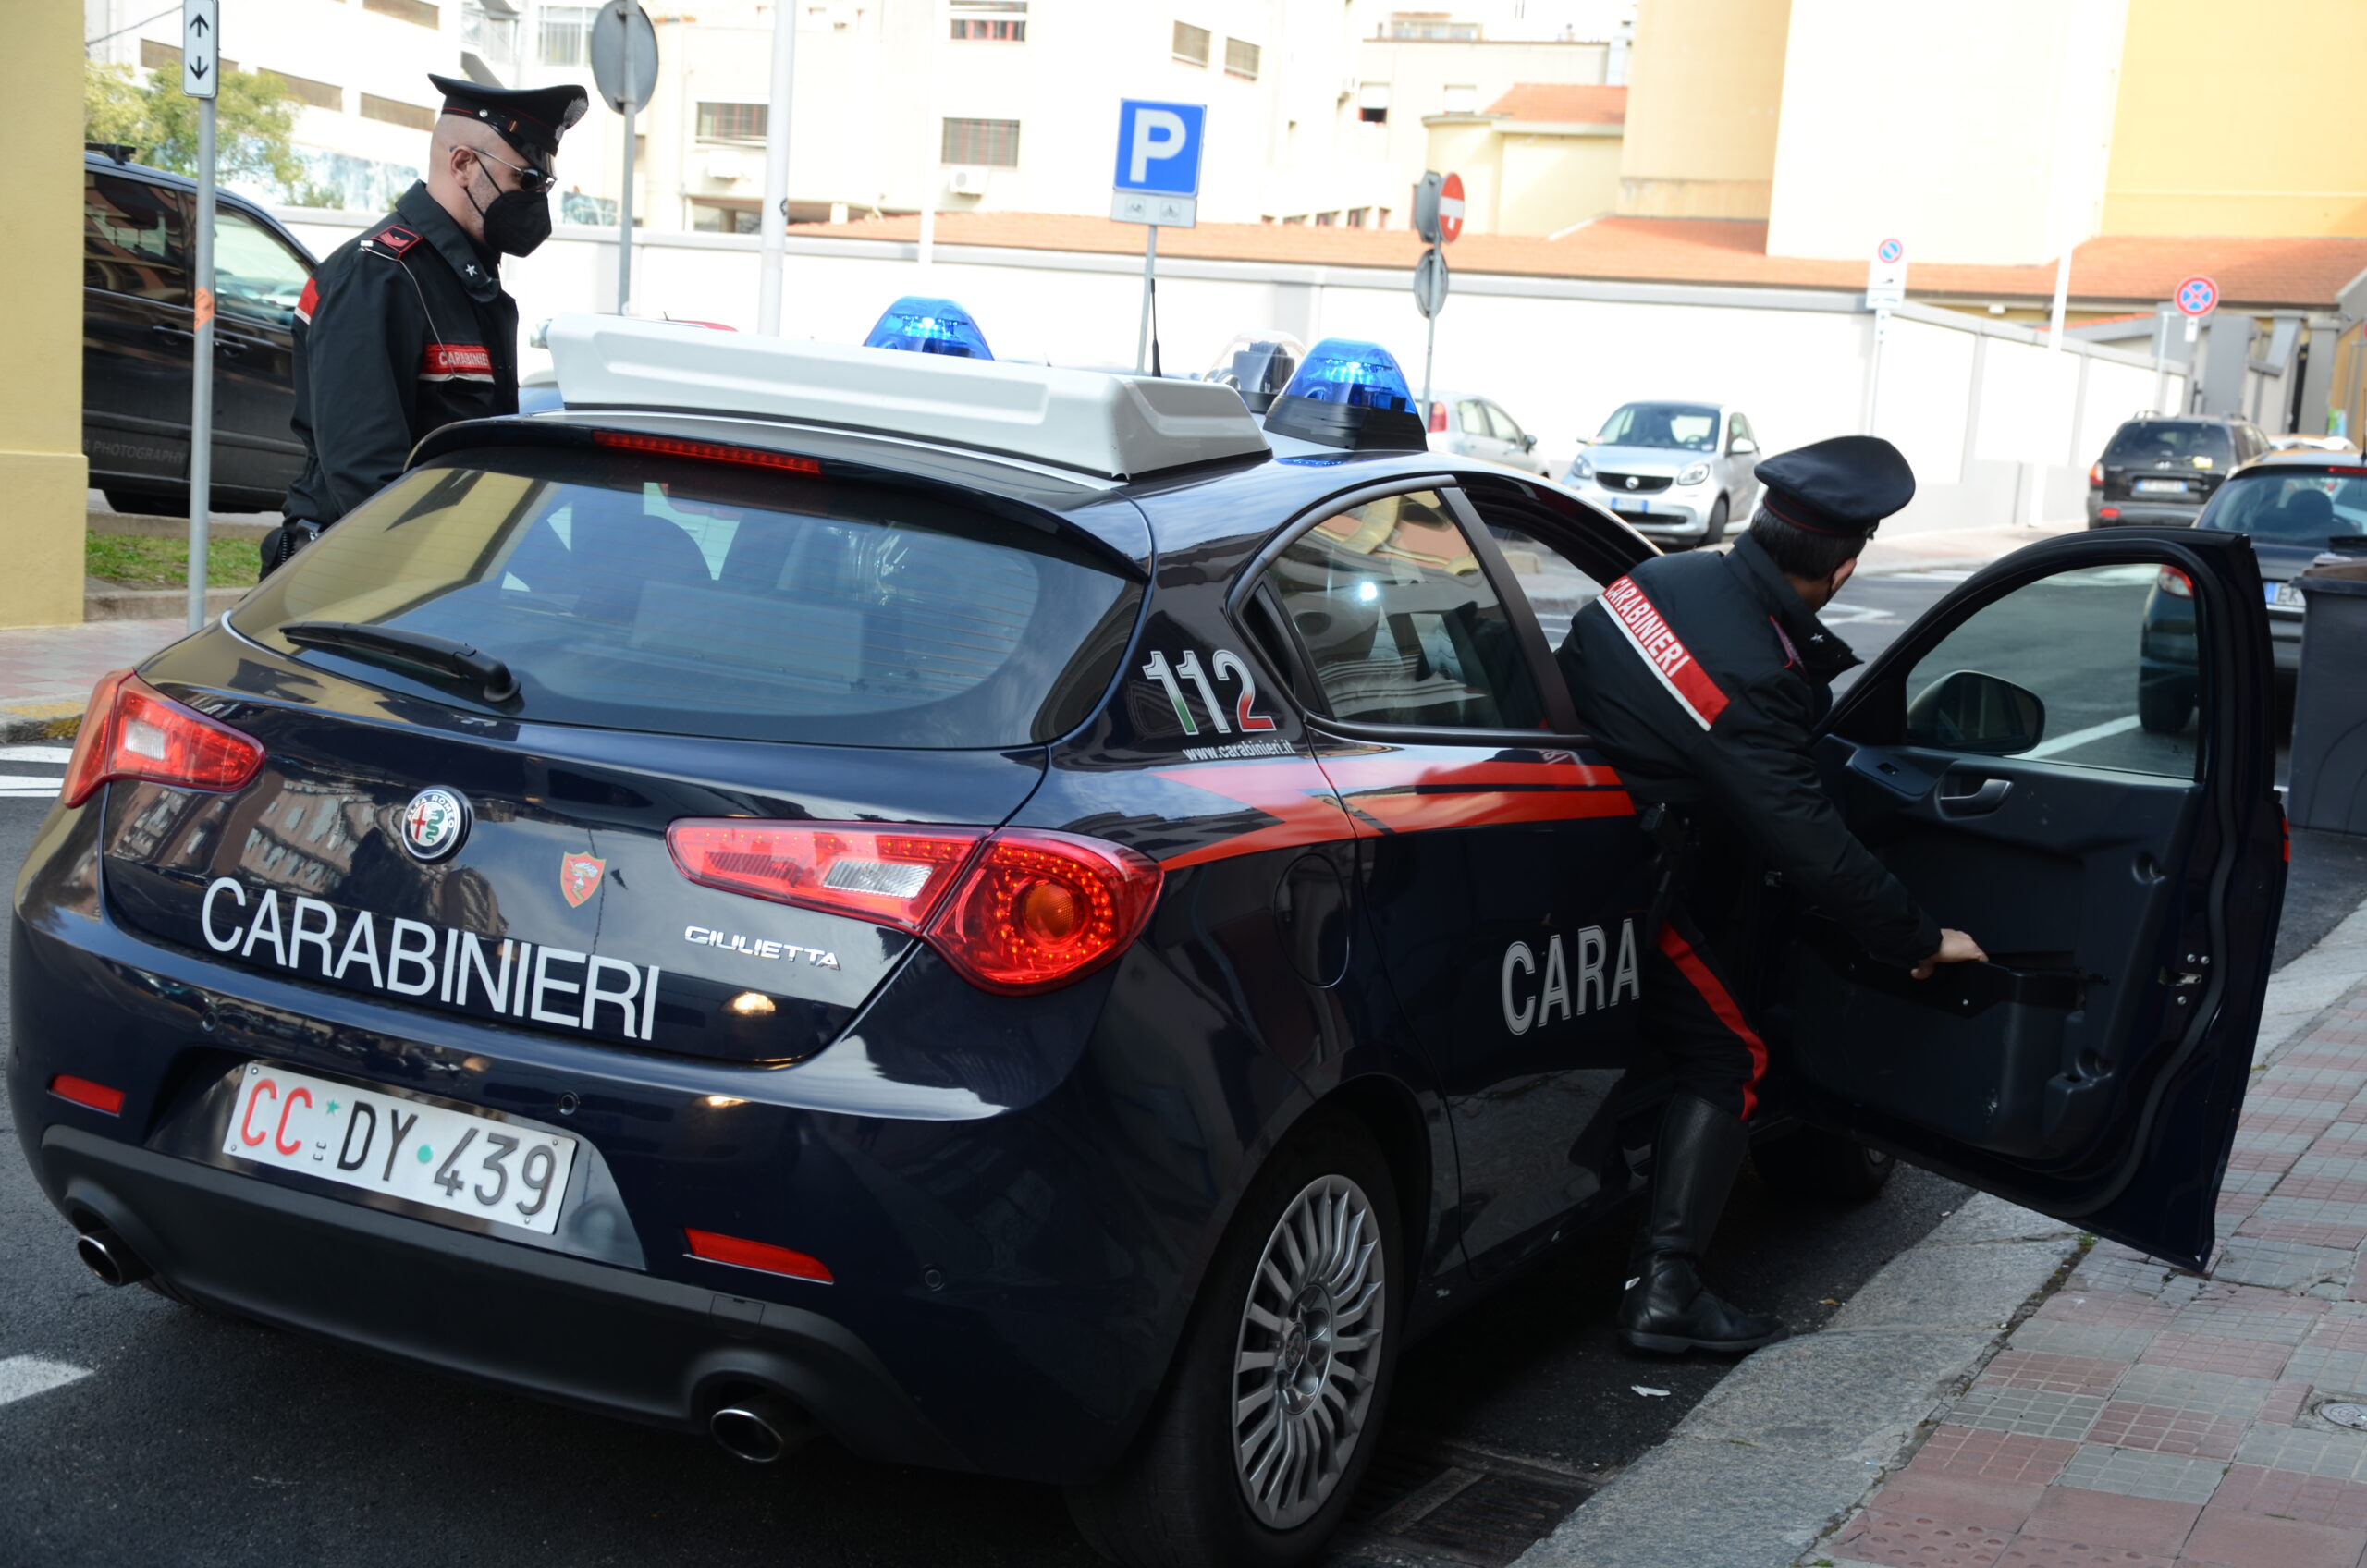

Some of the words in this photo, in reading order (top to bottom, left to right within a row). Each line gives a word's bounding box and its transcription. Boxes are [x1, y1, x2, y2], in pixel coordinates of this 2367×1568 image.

[1129, 108, 1187, 183] P
[438, 351, 489, 366] CARABINIE
[93, 440, 187, 464] PHOTOGRAPHY
[1605, 578, 1691, 678] CARABINIERI
[1142, 649, 1277, 736] 112
[1182, 739, 1296, 762] www.carabinieri.it
[407, 797, 427, 821] ALFA
[431, 794, 456, 829] ROMEO
[202, 876, 660, 1041] CARABINIERI
[684, 925, 842, 971] GIULIETTA
[1501, 917, 1640, 1036] CARA
[240, 1078, 313, 1157] CC
[337, 1100, 419, 1182] DY
[434, 1127, 557, 1217] 439
